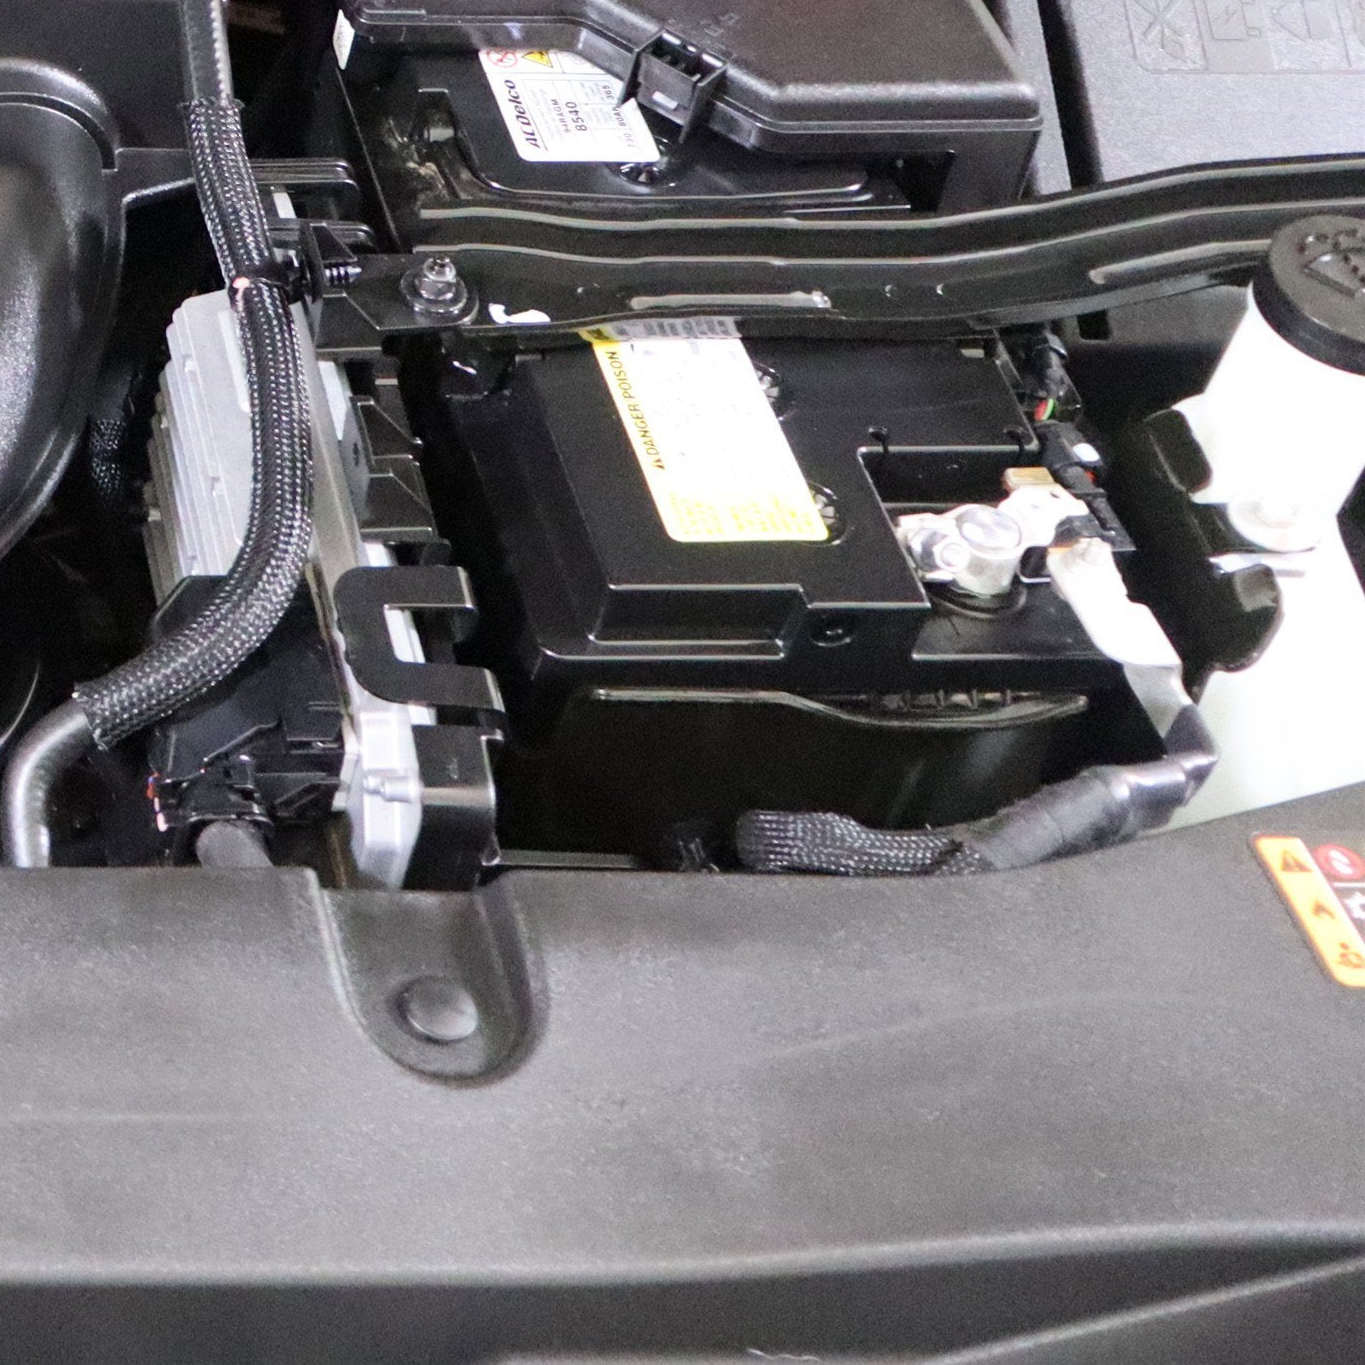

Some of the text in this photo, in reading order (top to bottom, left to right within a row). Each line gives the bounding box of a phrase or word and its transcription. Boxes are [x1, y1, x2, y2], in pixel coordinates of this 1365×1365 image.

[504, 79, 541, 149] ACDelco
[565, 101, 588, 132] 8540
[605, 350, 660, 456] DANGER POISON
